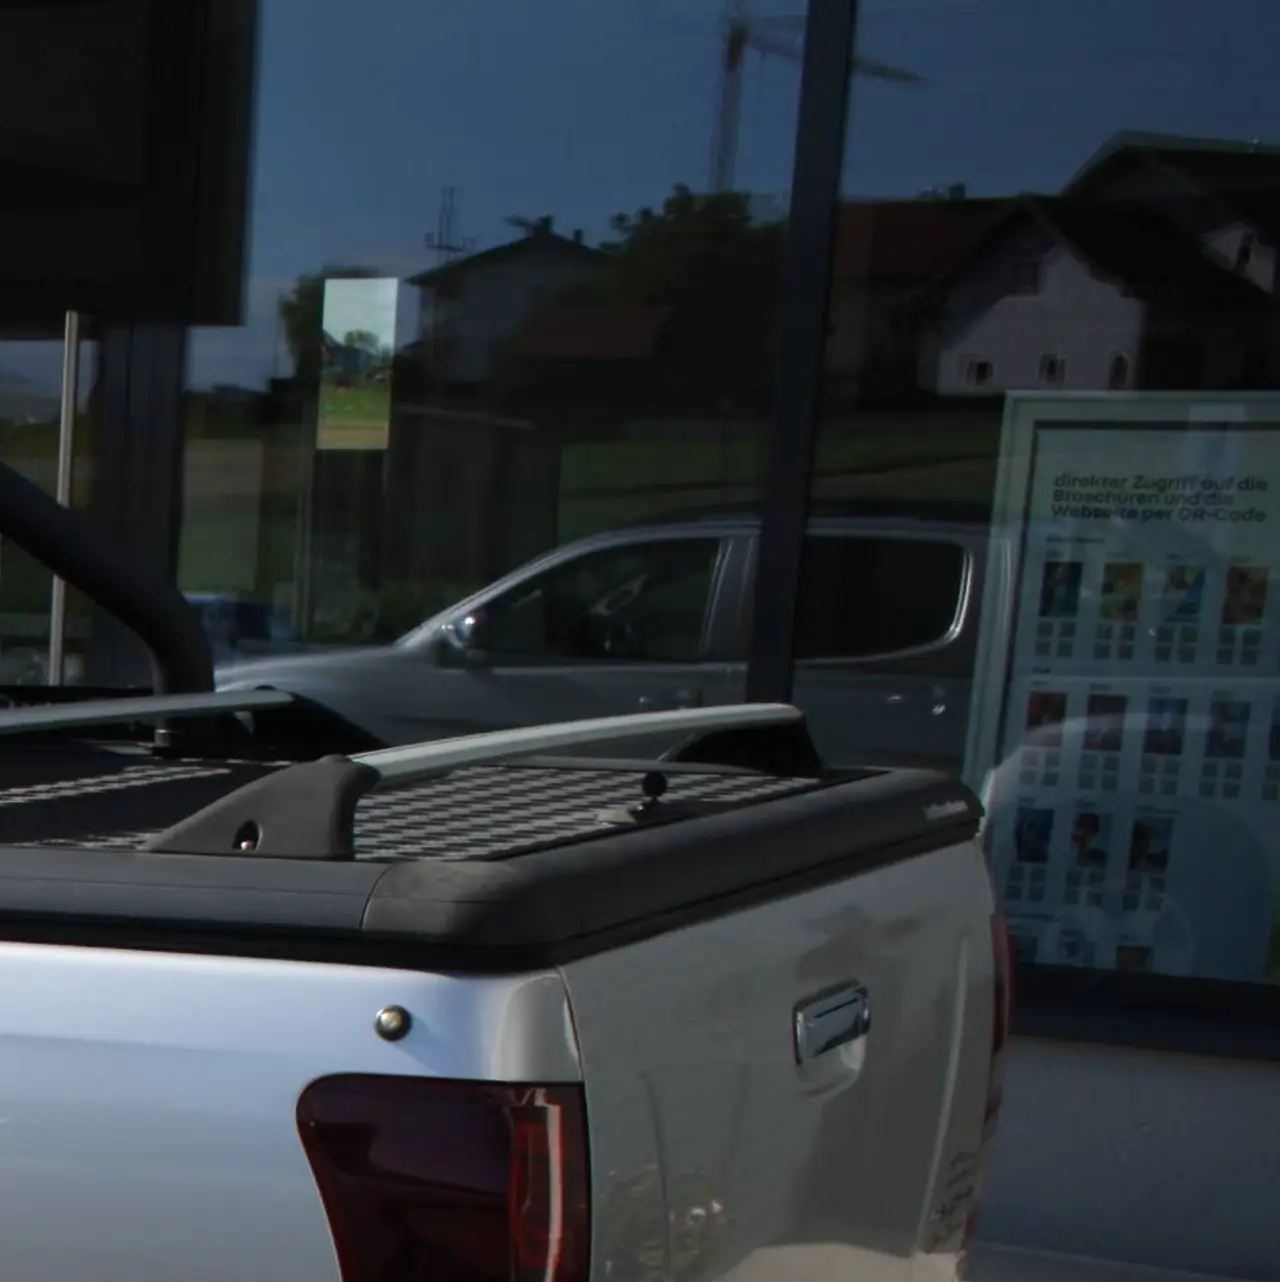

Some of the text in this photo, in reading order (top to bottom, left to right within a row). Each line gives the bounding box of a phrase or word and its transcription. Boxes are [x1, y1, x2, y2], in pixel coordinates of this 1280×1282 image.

[1132, 474, 1198, 492] Zugriff
[1200, 475, 1234, 490] auf
[1237, 475, 1269, 491] die
[1163, 491, 1200, 505] und
[1141, 508, 1174, 524] per
